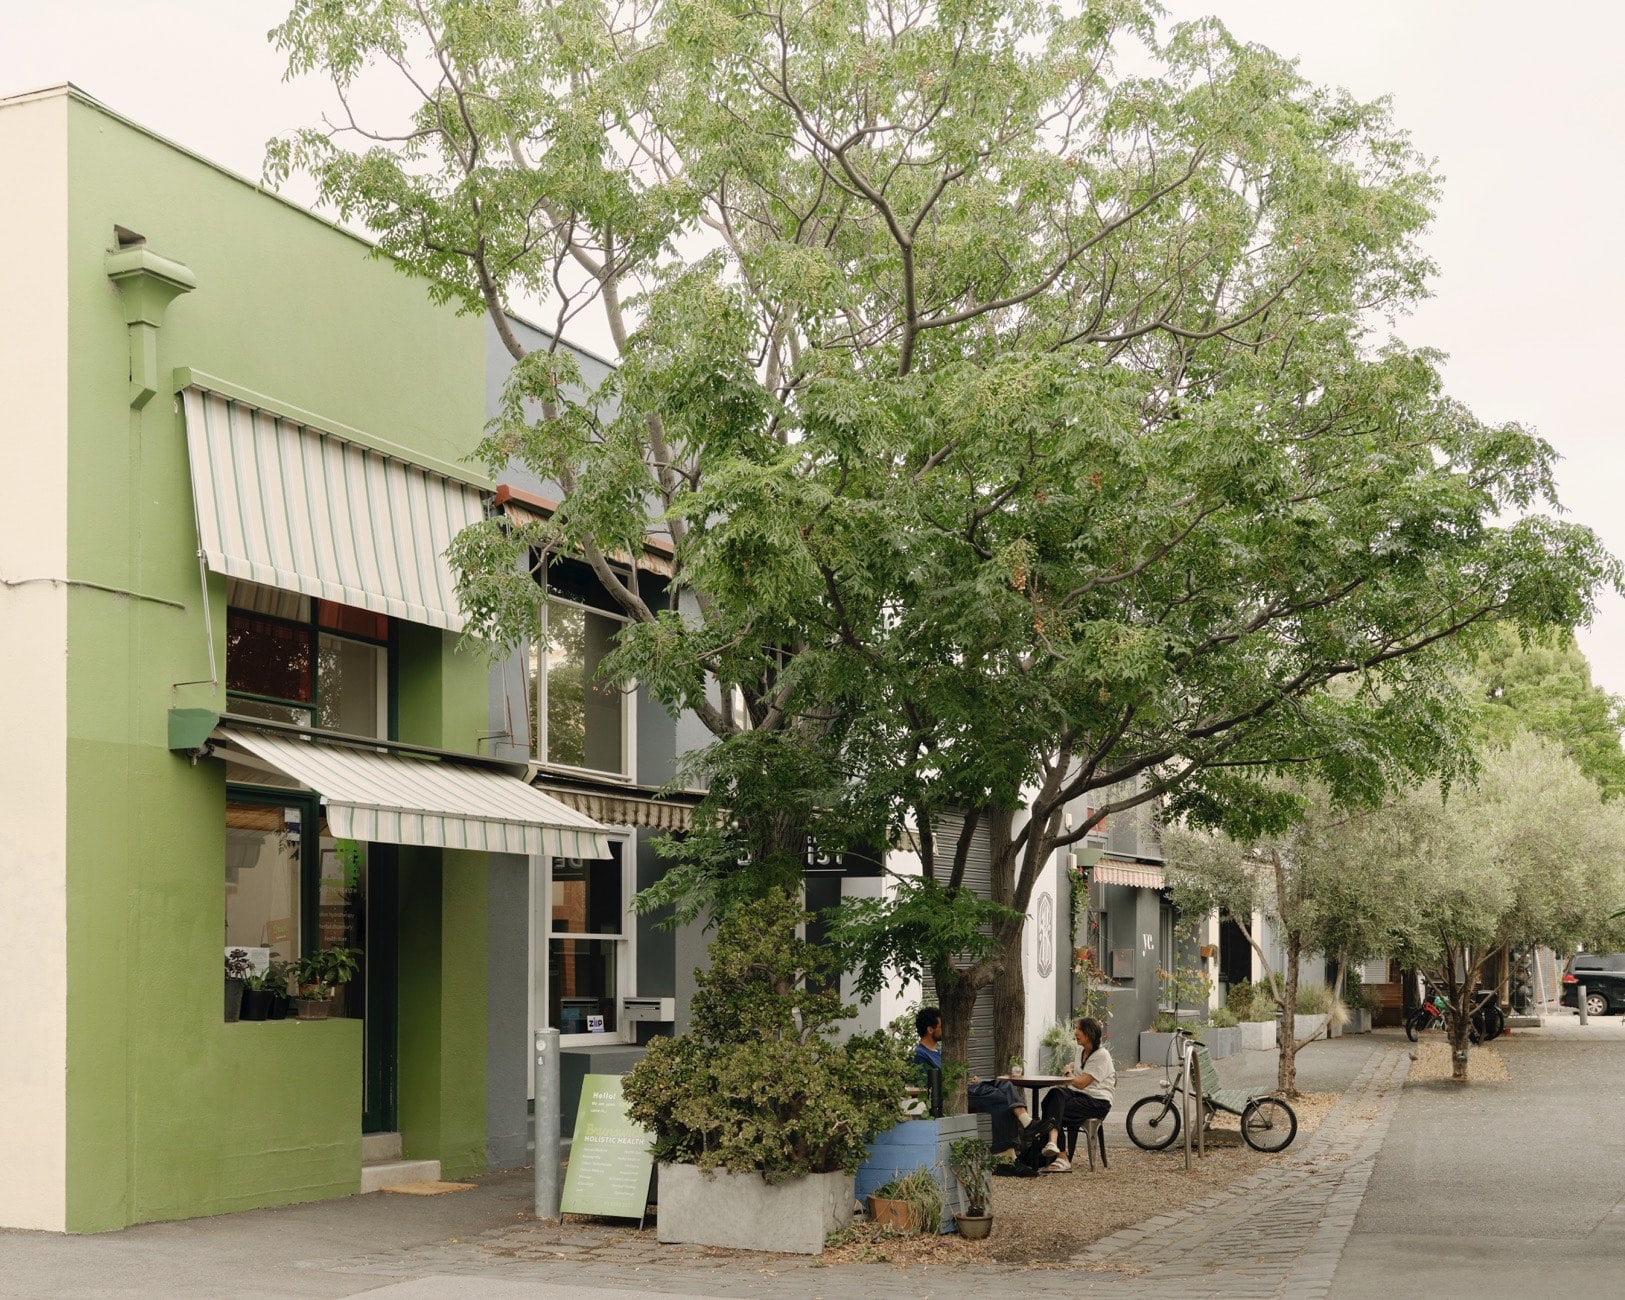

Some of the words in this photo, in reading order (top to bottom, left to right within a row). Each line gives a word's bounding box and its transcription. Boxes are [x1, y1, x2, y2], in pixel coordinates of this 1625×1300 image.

[593, 1092, 616, 1100] Hello!
[584, 1135, 617, 1144] HOLISTIC
[617, 1137, 645, 1145] HEALTH
